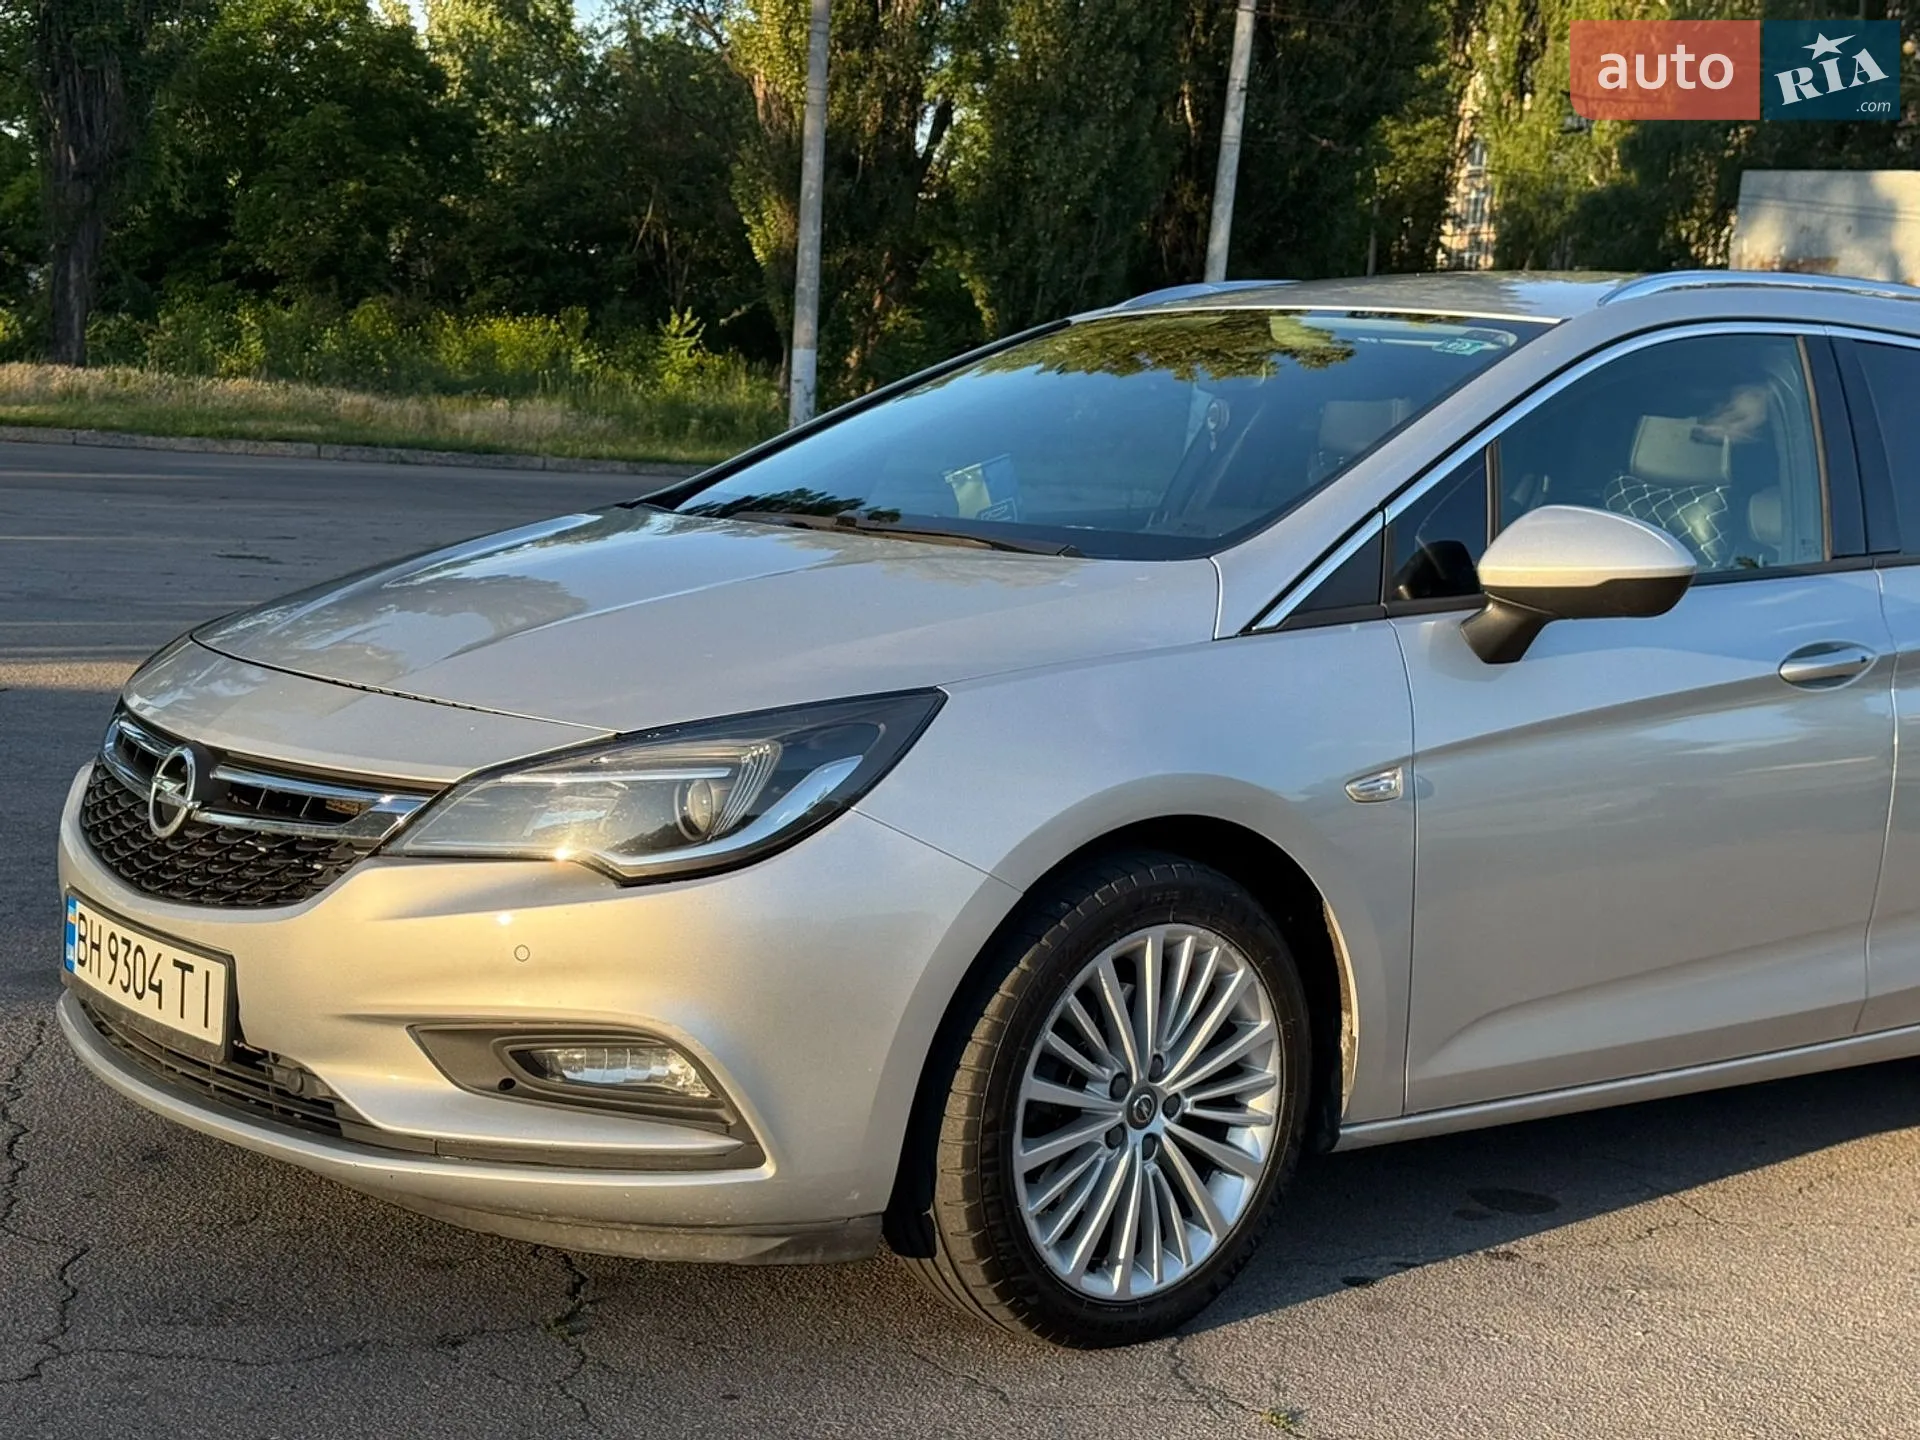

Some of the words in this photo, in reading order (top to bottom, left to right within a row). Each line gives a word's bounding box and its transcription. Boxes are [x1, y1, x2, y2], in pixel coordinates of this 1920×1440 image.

[78, 912, 102, 978] BH
[108, 932, 163, 1010] 9304
[173, 959, 210, 1028] TI
